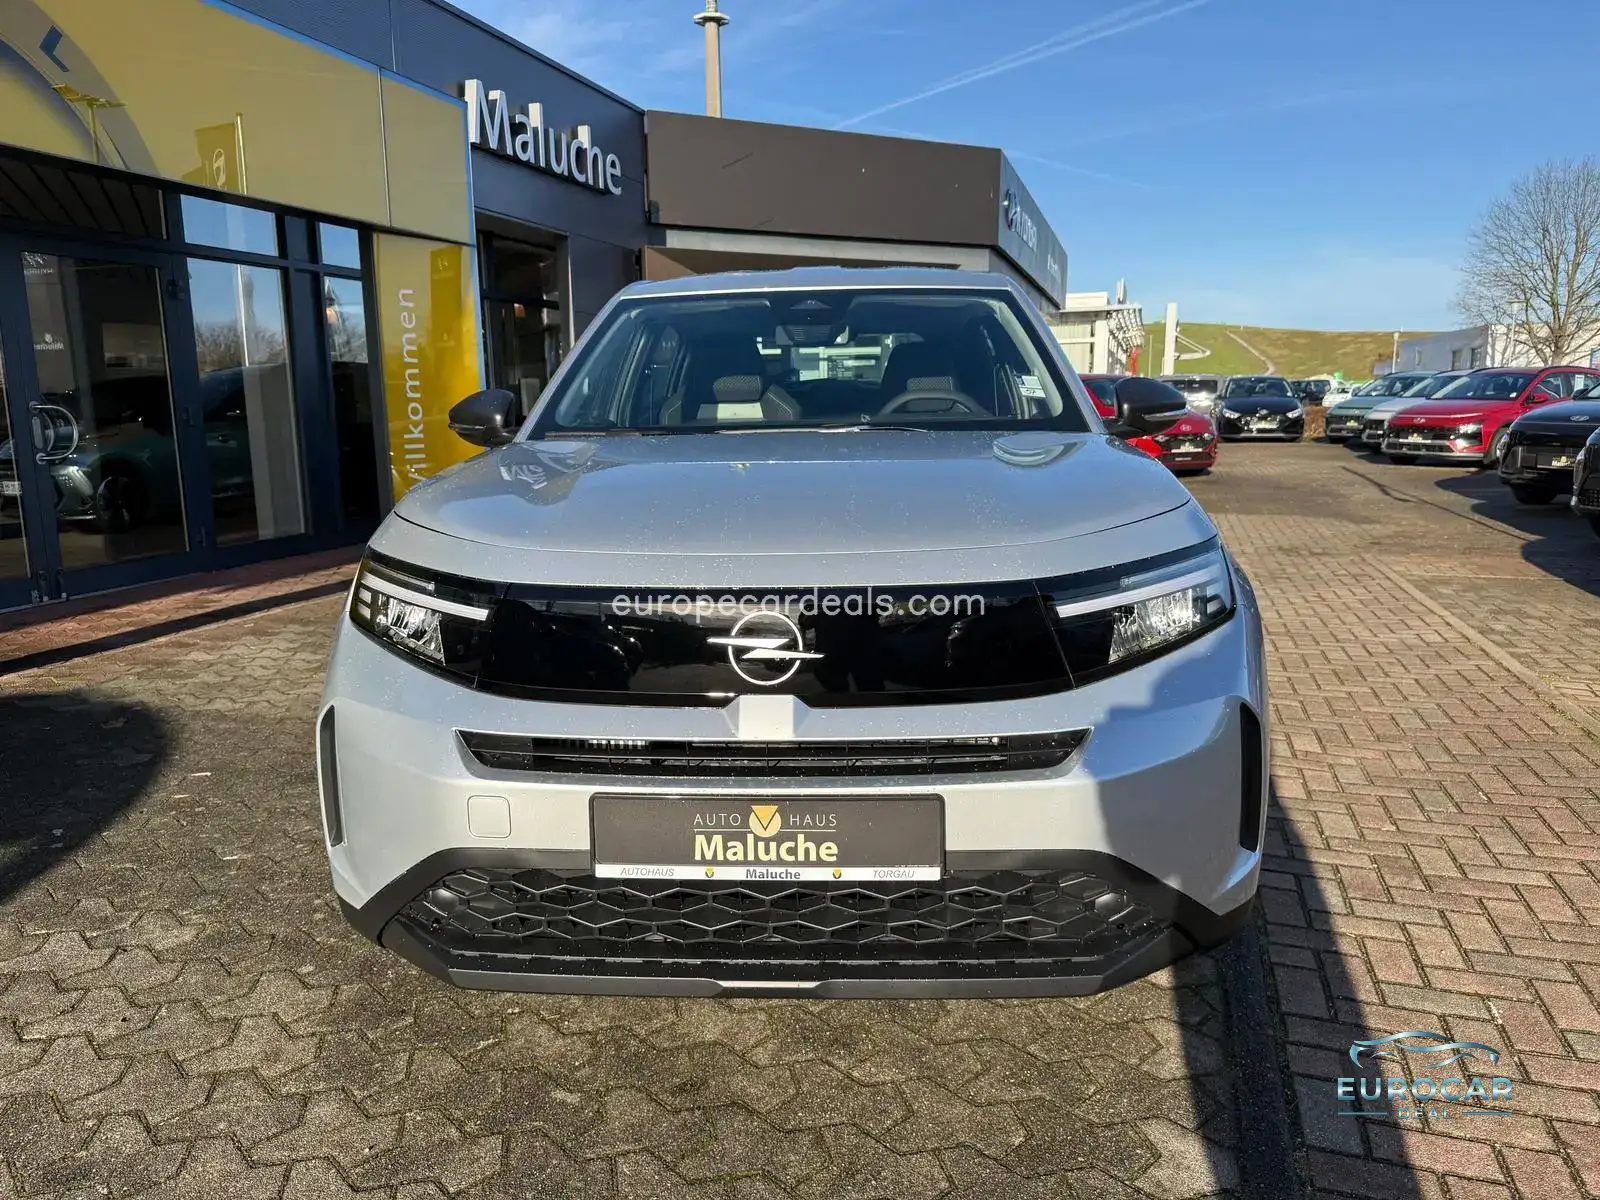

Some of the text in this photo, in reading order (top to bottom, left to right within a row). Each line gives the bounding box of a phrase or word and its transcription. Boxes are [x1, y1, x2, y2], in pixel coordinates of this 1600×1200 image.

[465, 79, 622, 195] Maluche
[399, 288, 429, 482] illkommen
[693, 813, 837, 826] AUTO HAUS
[694, 833, 839, 862] Maluche
[620, 867, 915, 880] AUTOHAUS Maluche TORGAU
